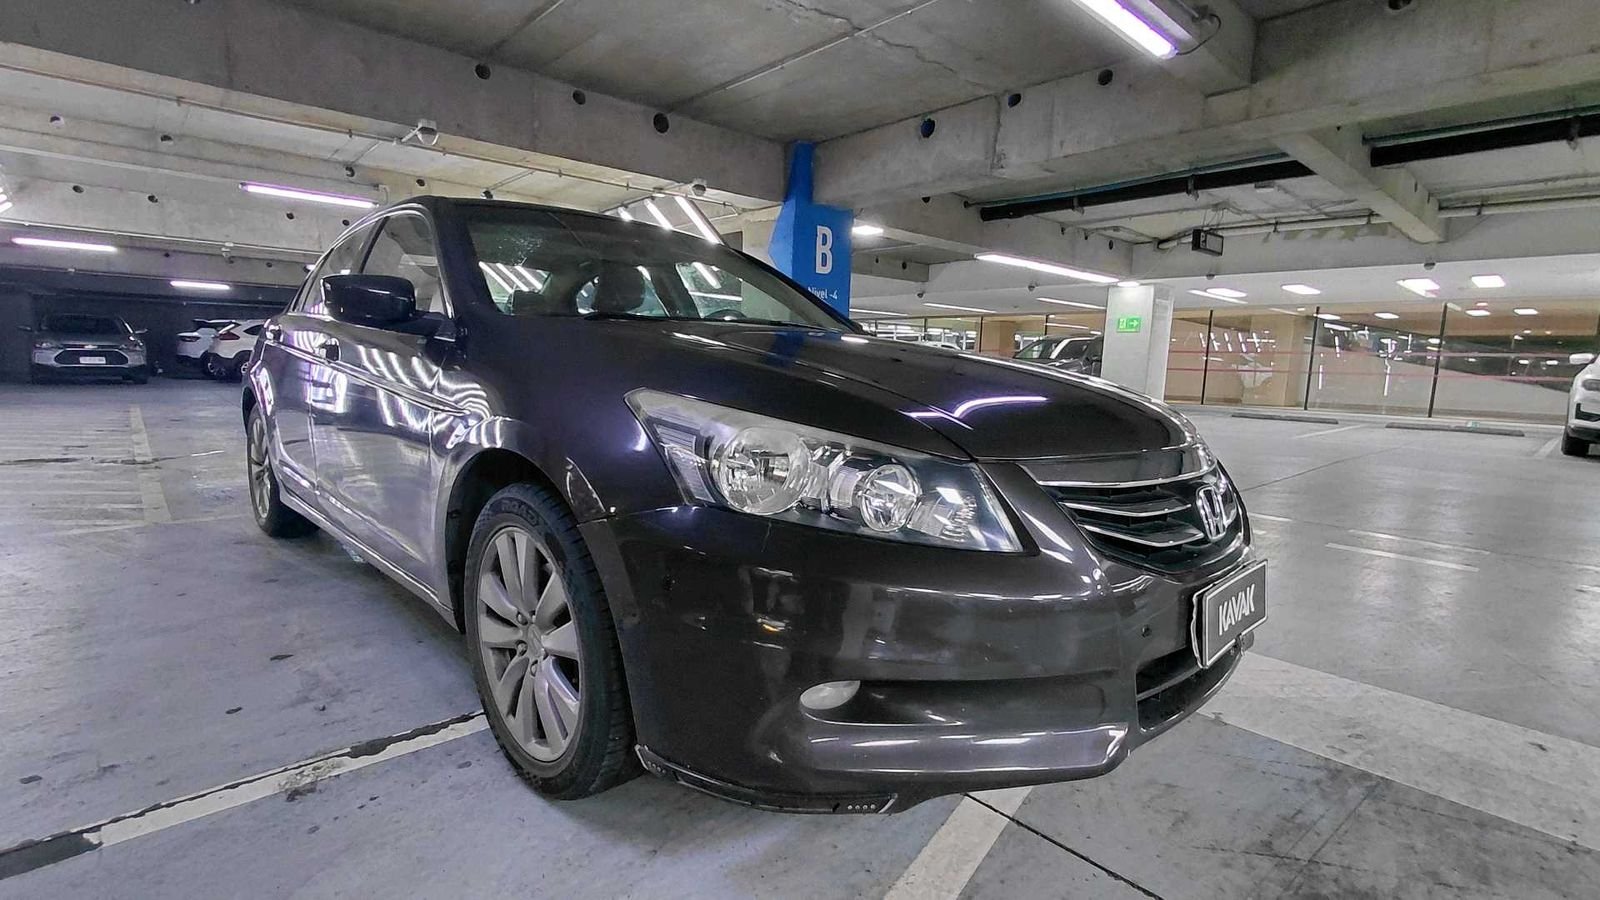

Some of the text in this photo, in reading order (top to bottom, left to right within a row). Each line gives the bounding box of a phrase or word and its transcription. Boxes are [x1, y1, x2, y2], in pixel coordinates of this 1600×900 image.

[815, 225, 833, 274] B
[829, 289, 838, 300] -4
[1219, 583, 1255, 636] KAVAK
